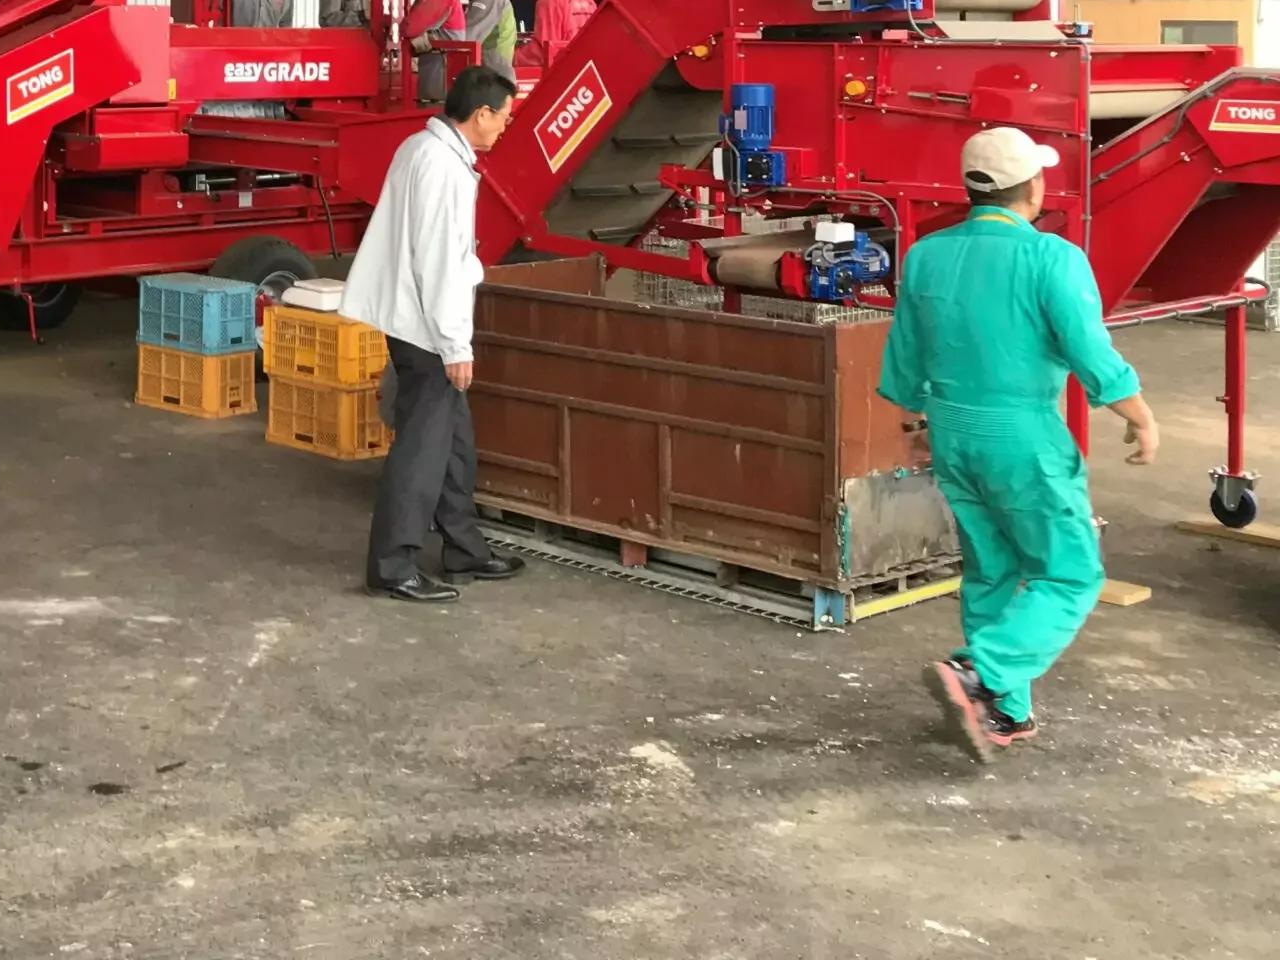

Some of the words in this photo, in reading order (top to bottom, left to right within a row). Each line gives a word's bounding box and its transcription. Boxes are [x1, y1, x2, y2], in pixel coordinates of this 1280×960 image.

[17, 65, 63, 98] TONG
[547, 86, 594, 139] TONG
[1227, 106, 1276, 120] TONG
